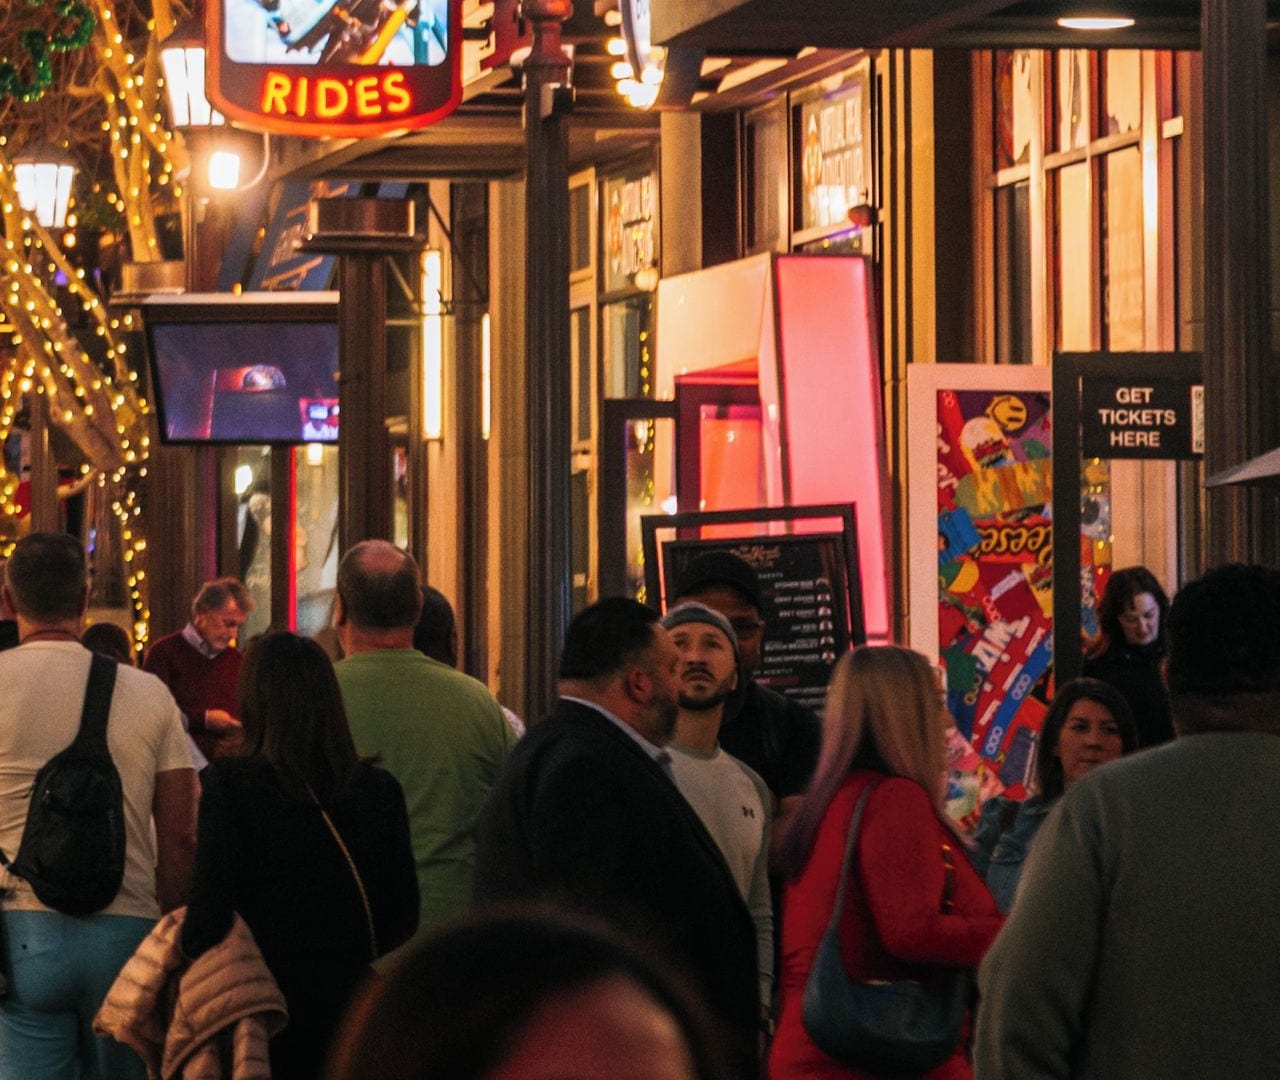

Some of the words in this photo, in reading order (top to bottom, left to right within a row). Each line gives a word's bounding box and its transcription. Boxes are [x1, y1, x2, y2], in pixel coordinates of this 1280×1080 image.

[262, 70, 412, 118] RIDES
[1115, 387, 1154, 404] GET
[1098, 408, 1177, 426] TICKETS
[1109, 431, 1161, 448] HERE
